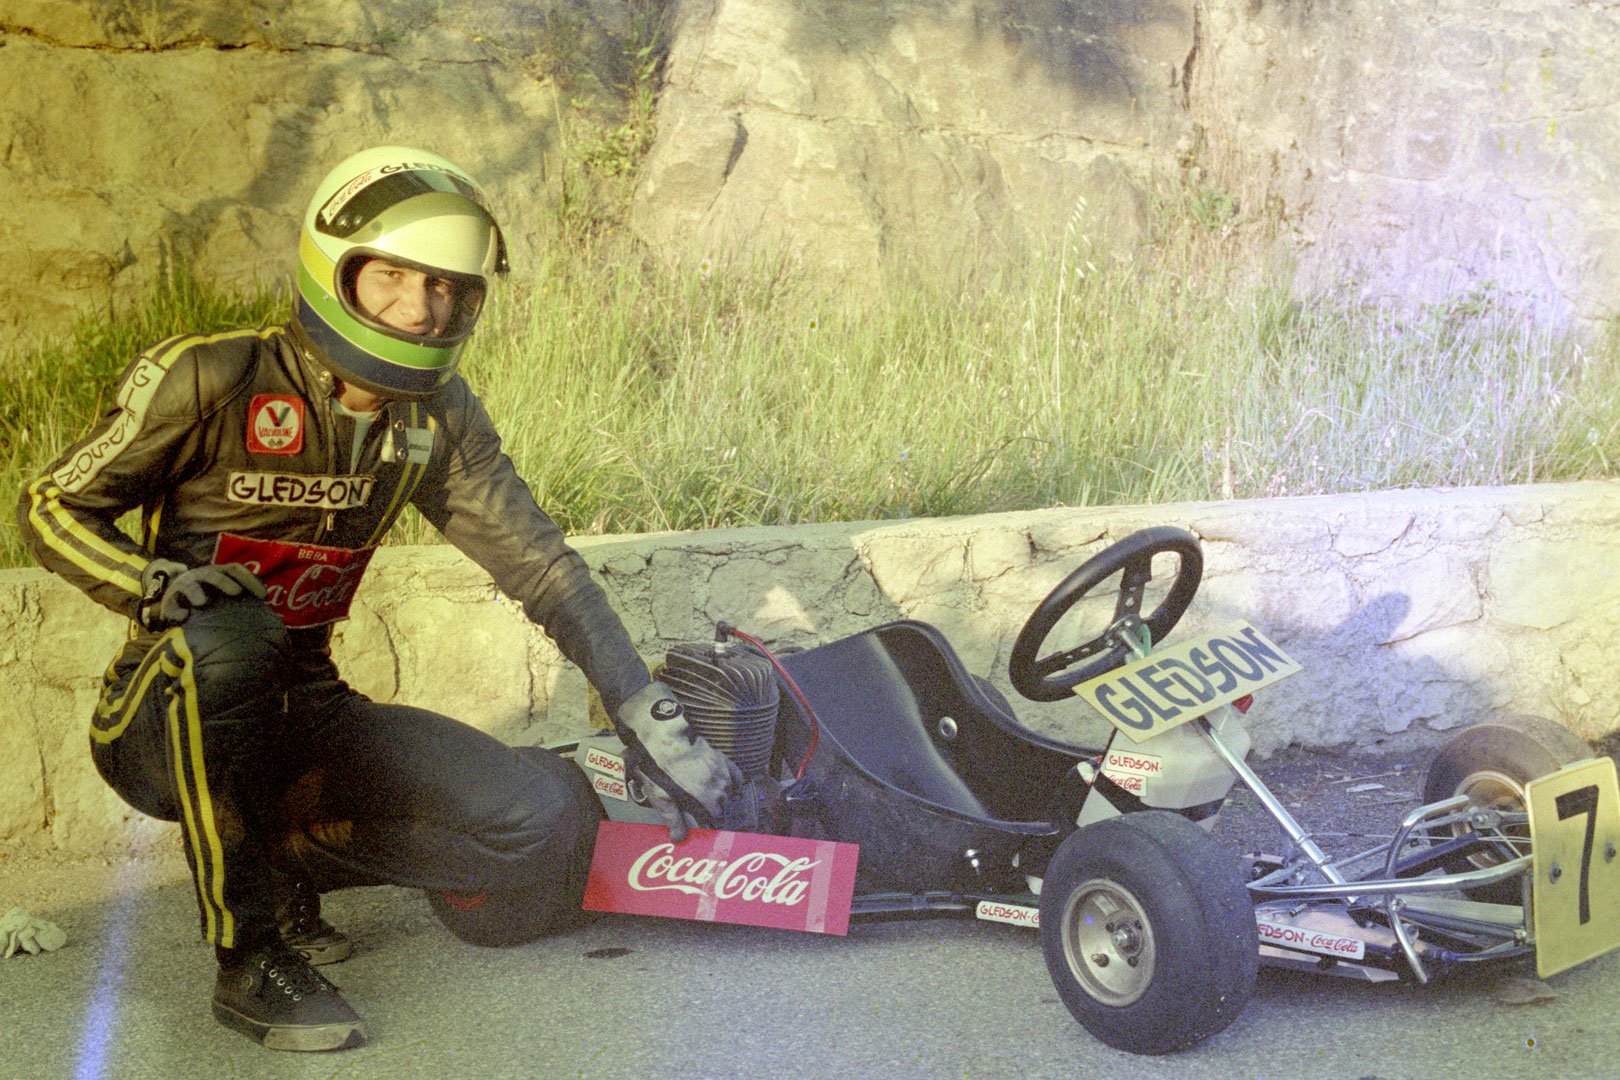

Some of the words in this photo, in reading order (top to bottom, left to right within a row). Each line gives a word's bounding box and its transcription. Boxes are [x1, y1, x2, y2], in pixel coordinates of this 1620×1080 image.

[258, 426, 294, 439] VALVOLINE
[231, 474, 371, 505] GLEDSON
[1094, 626, 1290, 731] GLEDSON
[588, 752, 625, 773] GLEDSON
[1554, 783, 1600, 926] 7
[627, 842, 823, 907] Coca-Cola
[1310, 934, 1360, 953] Coca-Cola
